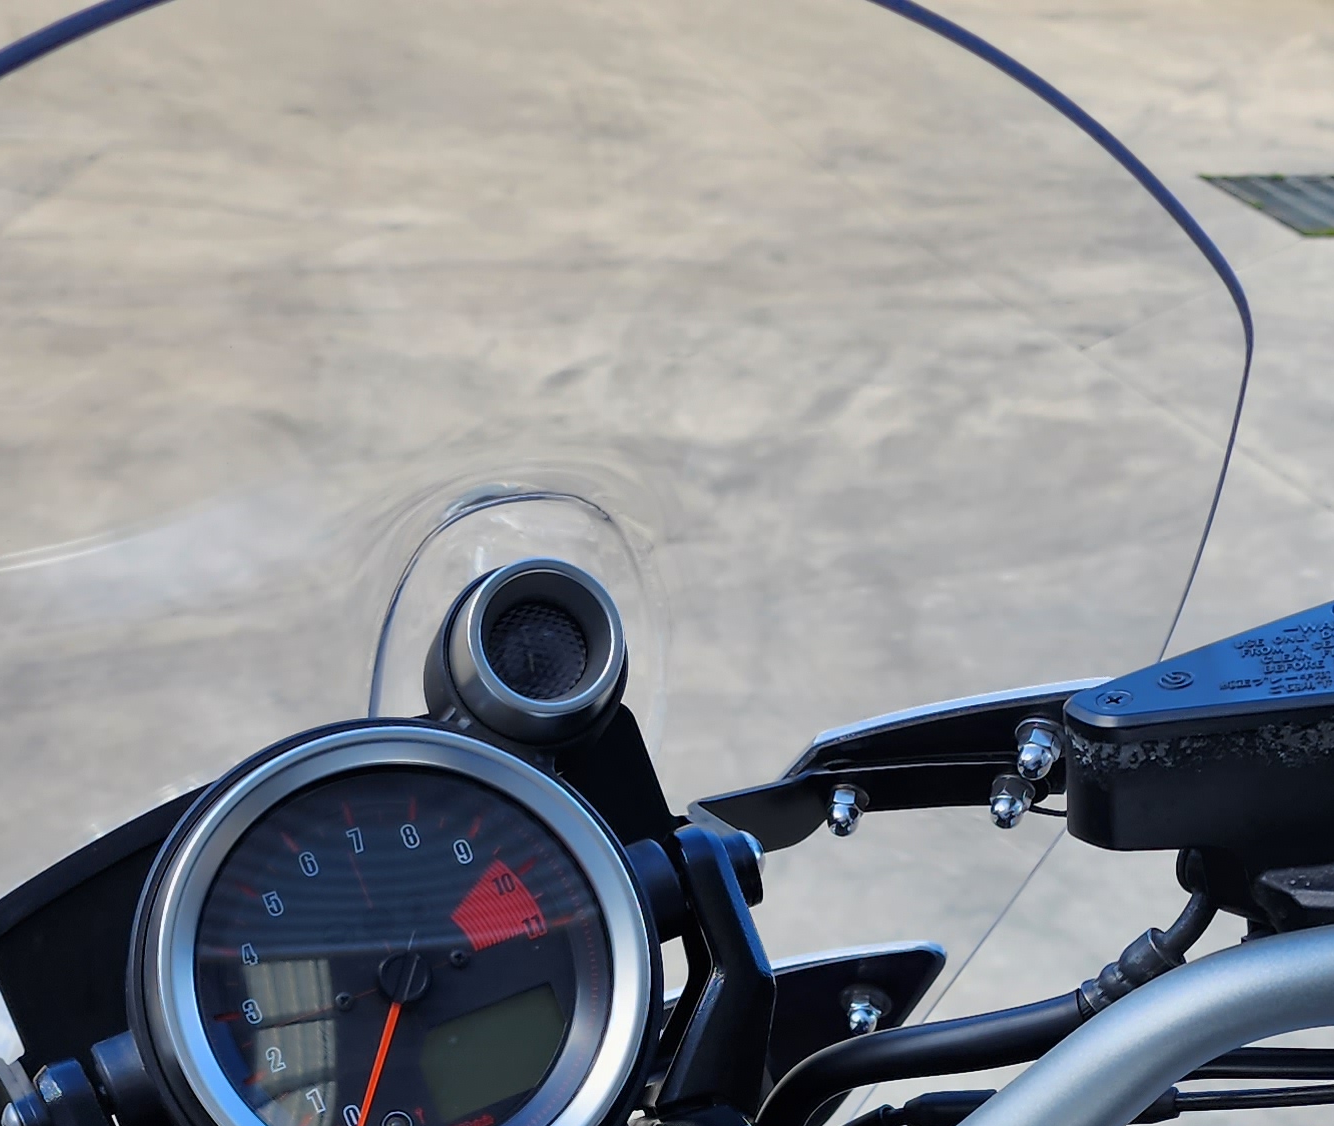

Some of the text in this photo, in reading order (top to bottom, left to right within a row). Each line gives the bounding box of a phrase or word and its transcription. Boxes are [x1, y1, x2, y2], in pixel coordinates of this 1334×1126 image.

[346, 828, 365, 854] 7
[399, 823, 421, 849] 8
[297, 851, 320, 877] 6
[452, 838, 474, 865] 9
[494, 872, 517, 896] 10
[261, 891, 284, 917] 5
[521, 914, 547, 941] 11
[240, 943, 259, 966] 4
[241, 999, 264, 1025] 3
[265, 1047, 287, 1073] 2
[305, 1088, 327, 1114] 1
